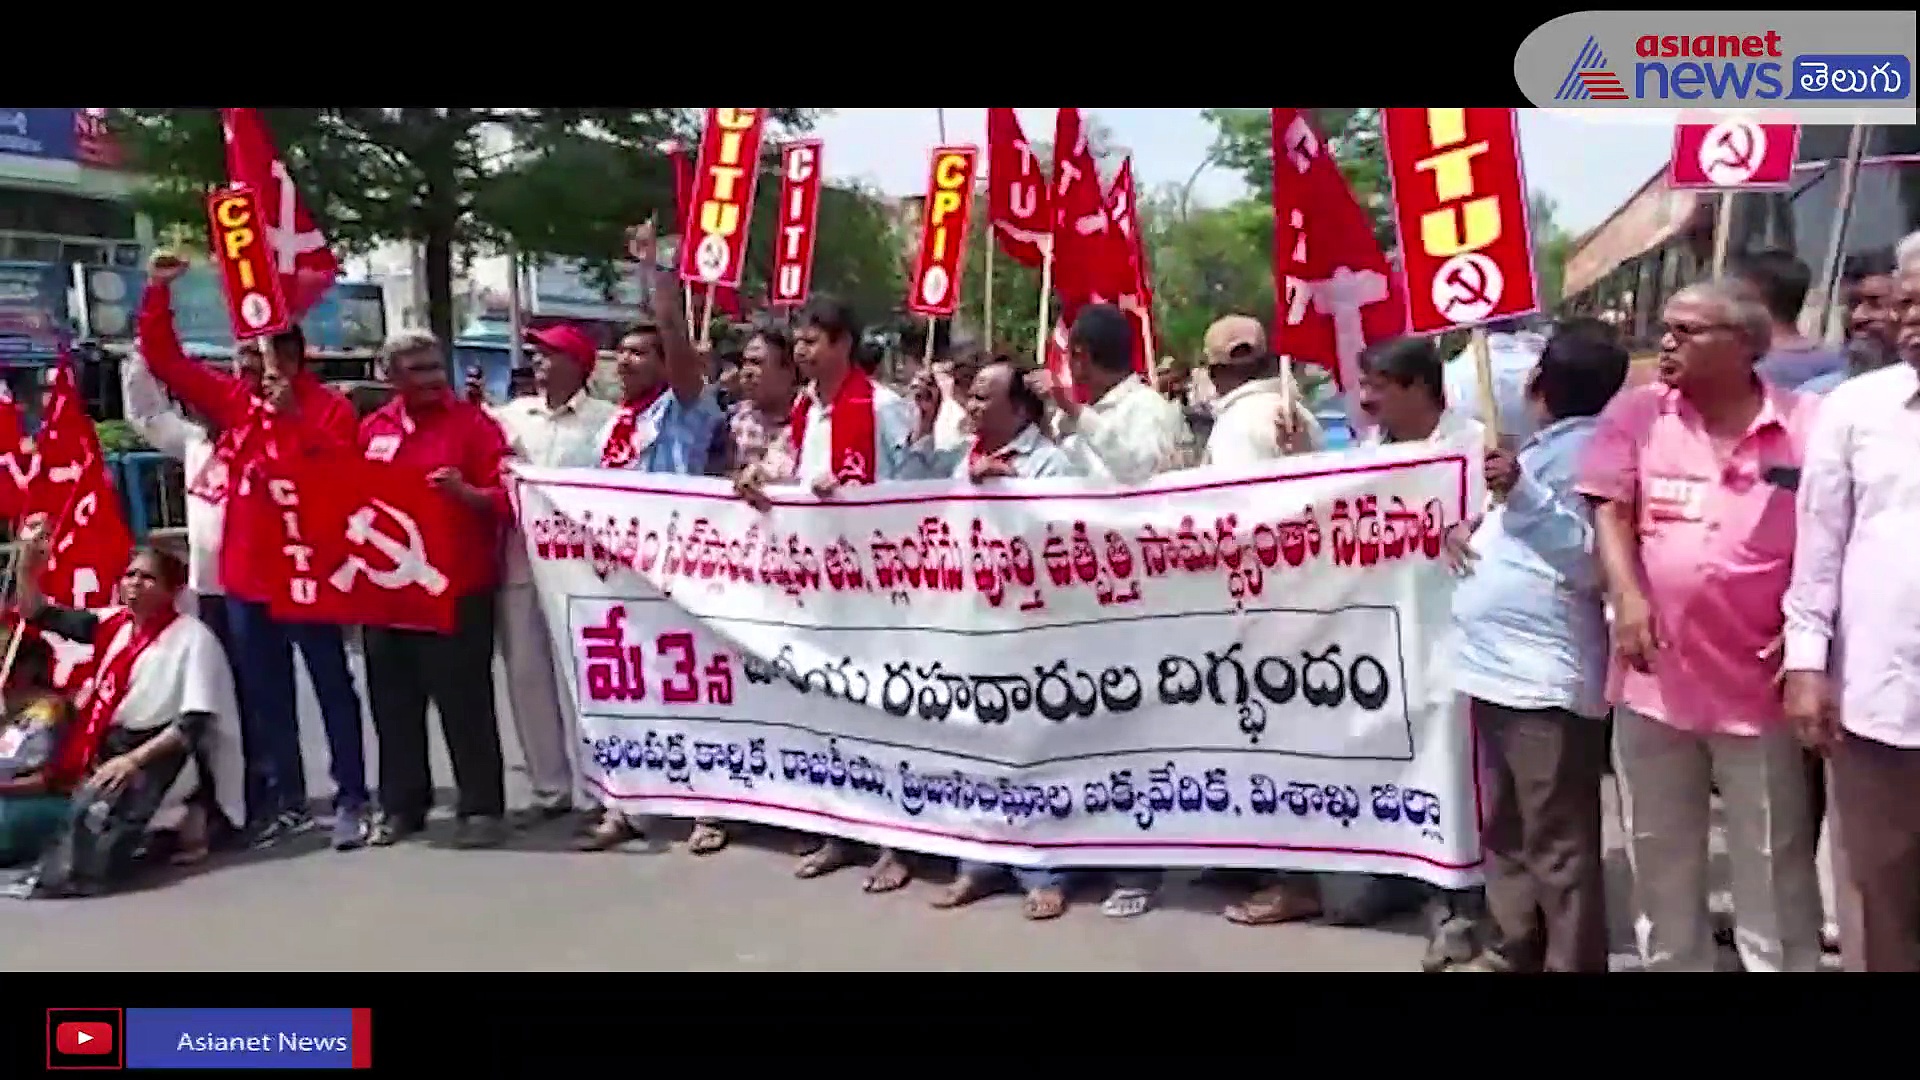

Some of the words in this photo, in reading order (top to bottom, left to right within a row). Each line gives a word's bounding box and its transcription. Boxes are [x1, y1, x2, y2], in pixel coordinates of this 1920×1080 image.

[216, 198, 255, 291] CPI
[779, 147, 815, 299] CITU
[932, 153, 966, 260] CPI
[268, 478, 318, 605] CITU
[582, 605, 646, 701] మే
[882, 659, 1143, 724] రహదారుల
[582, 730, 695, 792] ఖిలపక్ష
[1250, 773, 1360, 828] విశాఖ
